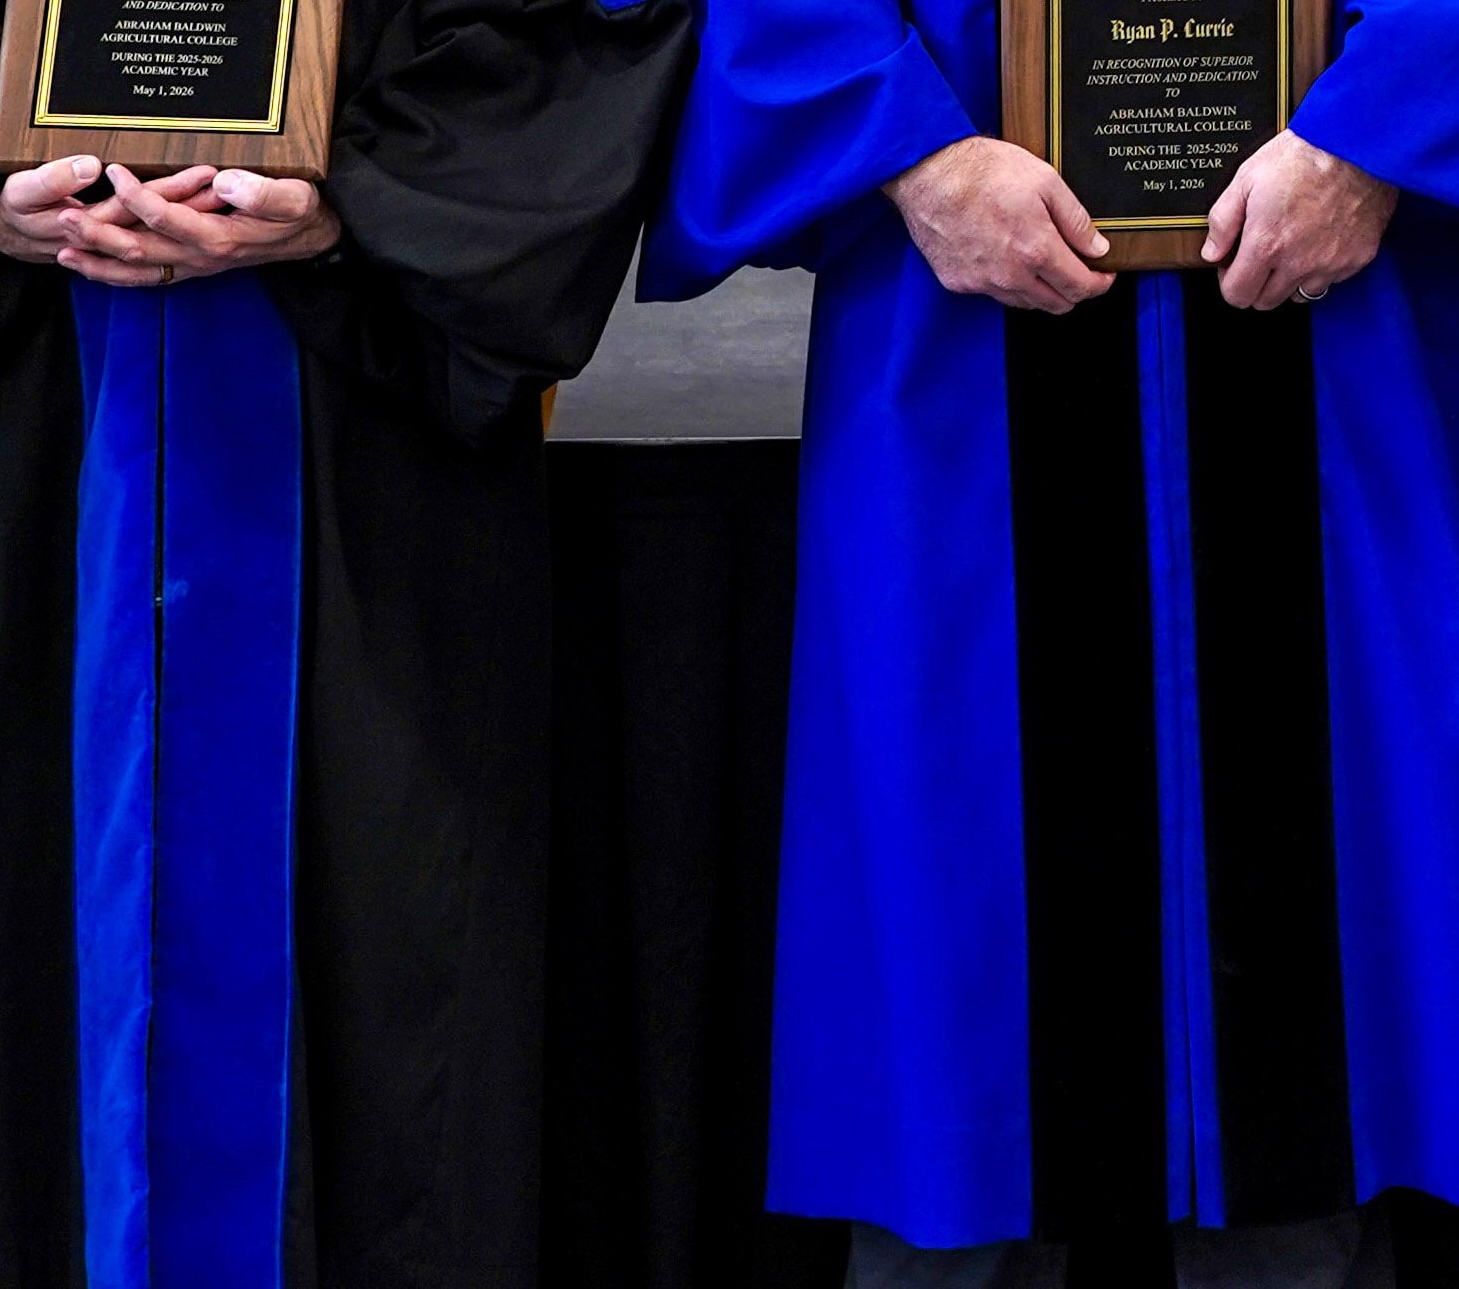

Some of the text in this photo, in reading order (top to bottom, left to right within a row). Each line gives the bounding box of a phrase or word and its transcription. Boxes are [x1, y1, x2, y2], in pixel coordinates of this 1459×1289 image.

[114, 19, 226, 32] ABRAHAM BALDWIN
[1110, 17, 1234, 44] Ryan P. Currie
[100, 32, 238, 46] AGRICULTURAL COLLEGE
[1091, 55, 1254, 70] IN RECOGNITION OF SUPERIOR
[121, 64, 209, 76] ACADEMIC YEAR
[1086, 69, 1259, 85] INSTRUCTION AND DEDICATION
[132, 84, 156, 97] May
[168, 85, 194, 96] 2026
[1165, 87, 1180, 98] TO
[1108, 105, 1237, 119] ABRAHAM BALDWIN
[1093, 119, 1252, 135] AGRICULTURAL COLLEGE
[1108, 142, 1239, 157] DURING THE 2025-2026
[1123, 157, 1223, 171] ACADEMIC YEAR
[1143, 179, 1166, 192] May
[1179, 178, 1205, 189] 2026
